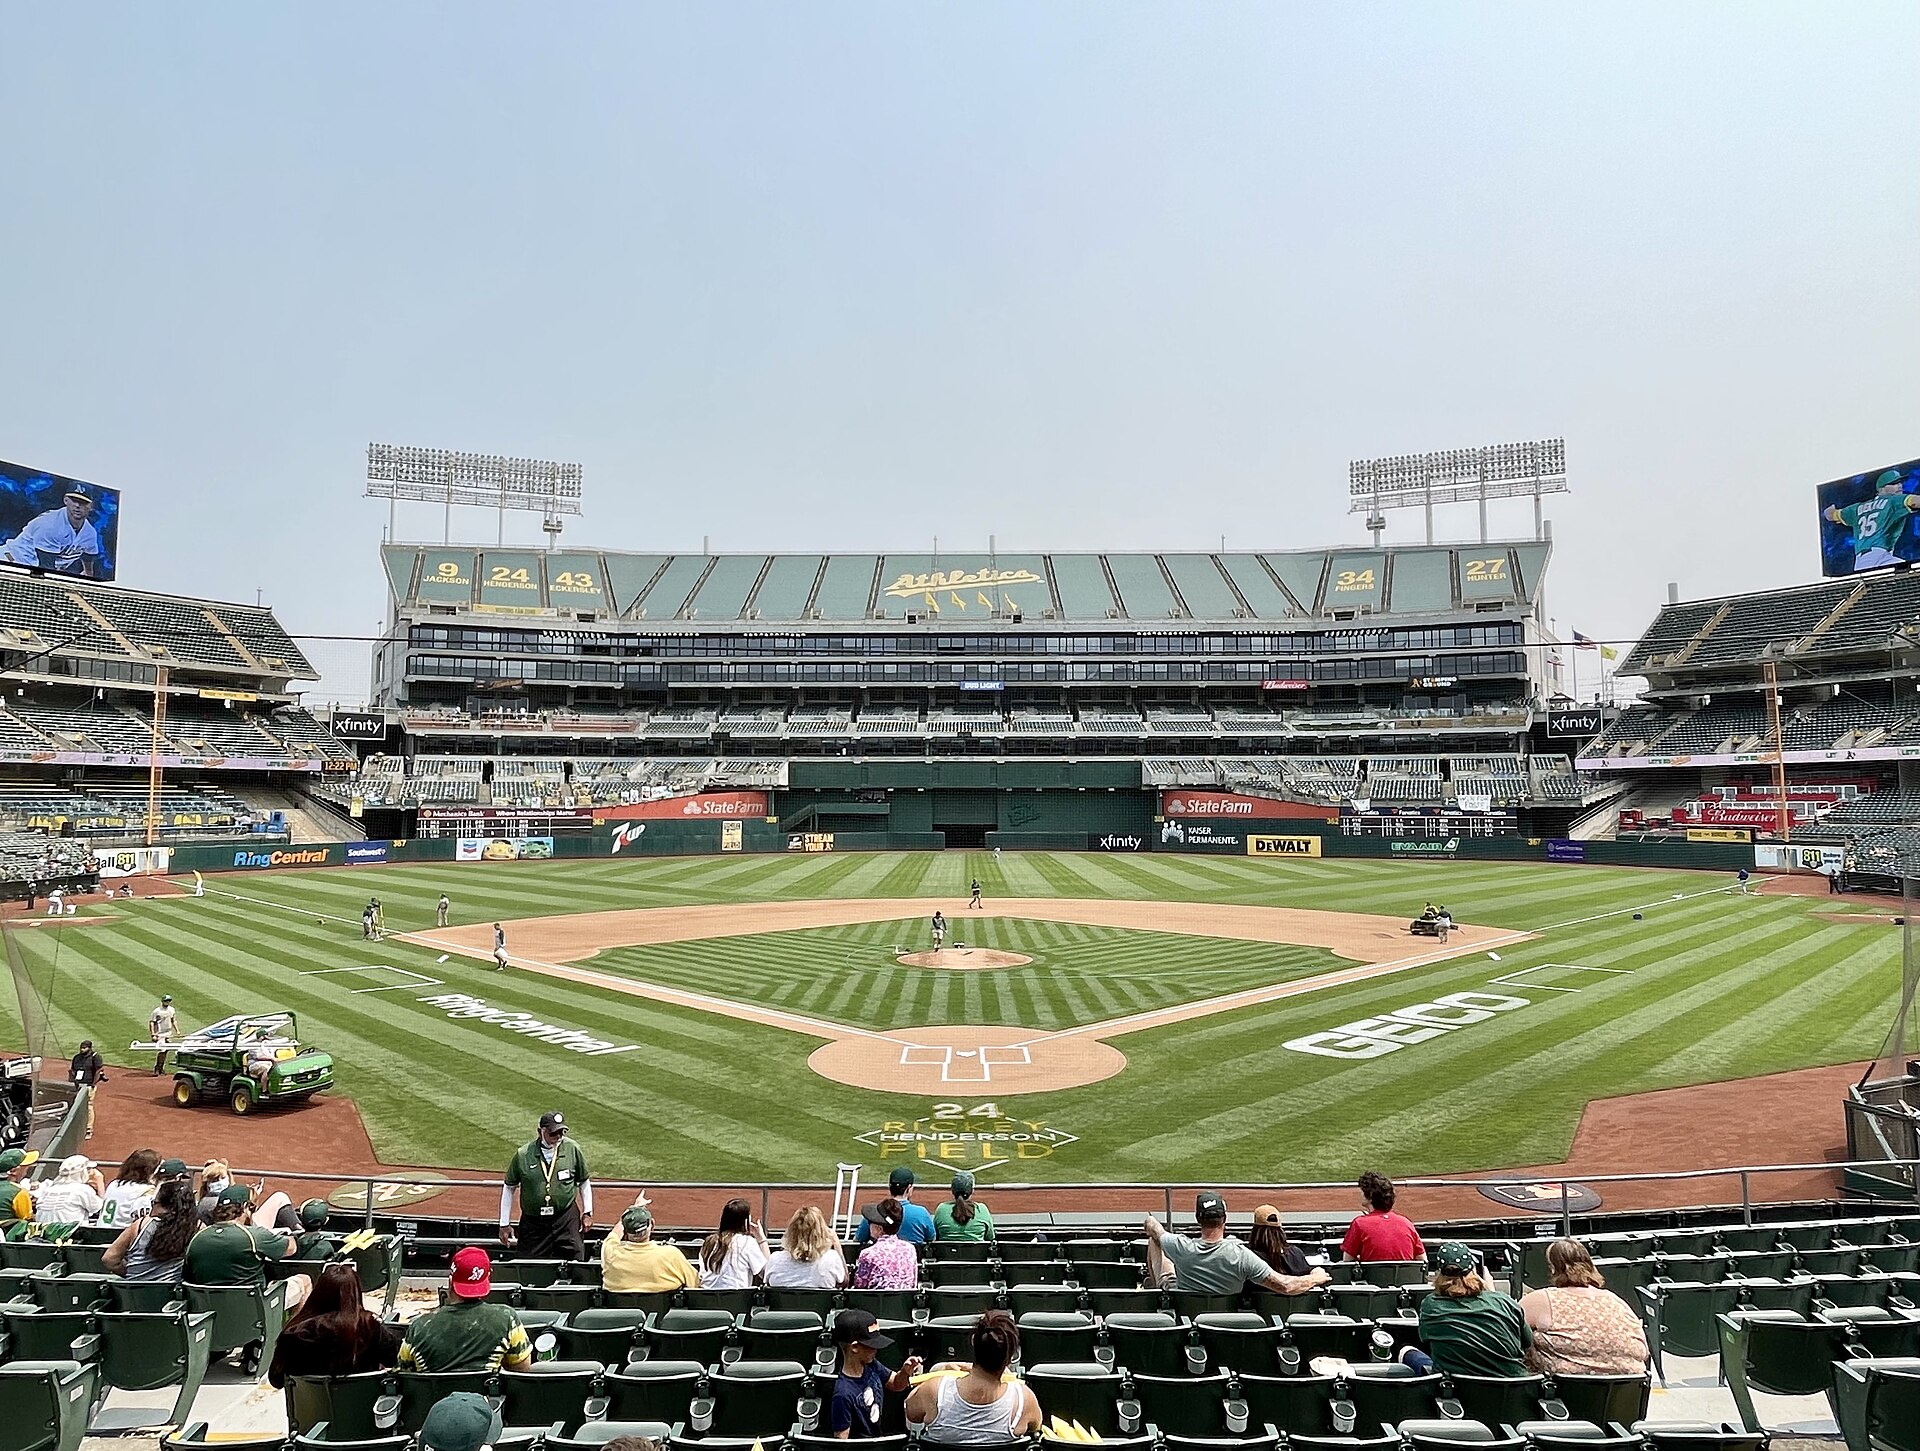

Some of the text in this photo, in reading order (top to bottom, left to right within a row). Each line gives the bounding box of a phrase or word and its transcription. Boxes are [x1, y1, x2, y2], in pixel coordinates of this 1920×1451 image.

[1857, 511, 1880, 540] 35
[438, 563, 459, 577] 9
[1466, 558, 1505, 577] 27
[423, 575, 470, 585] JACKSON
[491, 567, 530, 582] 24
[555, 571, 593, 588] 43
[1337, 569, 1375, 586] 34
[1467, 573, 1506, 582] HUNTER
[483, 581, 538, 590] HENDERSON
[550, 585, 602, 594] ECKERSLEY
[883, 568, 1044, 598] Athletics
[1335, 583, 1374, 592] FINGERS
[1263, 680, 1307, 690] Budweiser
[335, 717, 382, 735] xfinity
[1551, 715, 1598, 732] xfinity
[345, 761, 357, 770] PM
[703, 800, 763, 814] StateFarm
[1186, 800, 1253, 814] StateFarm
[1327, 817, 1339, 825] 362
[1708, 809, 1777, 823] Budweiser
[1188, 827, 1211, 835] KAISER
[805, 834, 834, 842] STREAM
[1100, 834, 1142, 850] xfinity
[1527, 838, 1541, 846] 367
[348, 848, 381, 856] Southwest
[805, 843, 824, 851] YOUR
[1419, 842, 1443, 850] AIR
[117, 852, 136, 865] 811
[234, 848, 329, 867] RingCentral
[1803, 850, 1820, 862] 811
[416, 994, 642, 1056] RingCentral
[1281, 992, 1531, 1059] GEICO
[932, 1102, 1005, 1120] 24
[883, 1121, 1046, 1132] RICKEY
[880, 1133, 1055, 1141] HENDERSON
[880, 1142, 1053, 1159] FIELD
